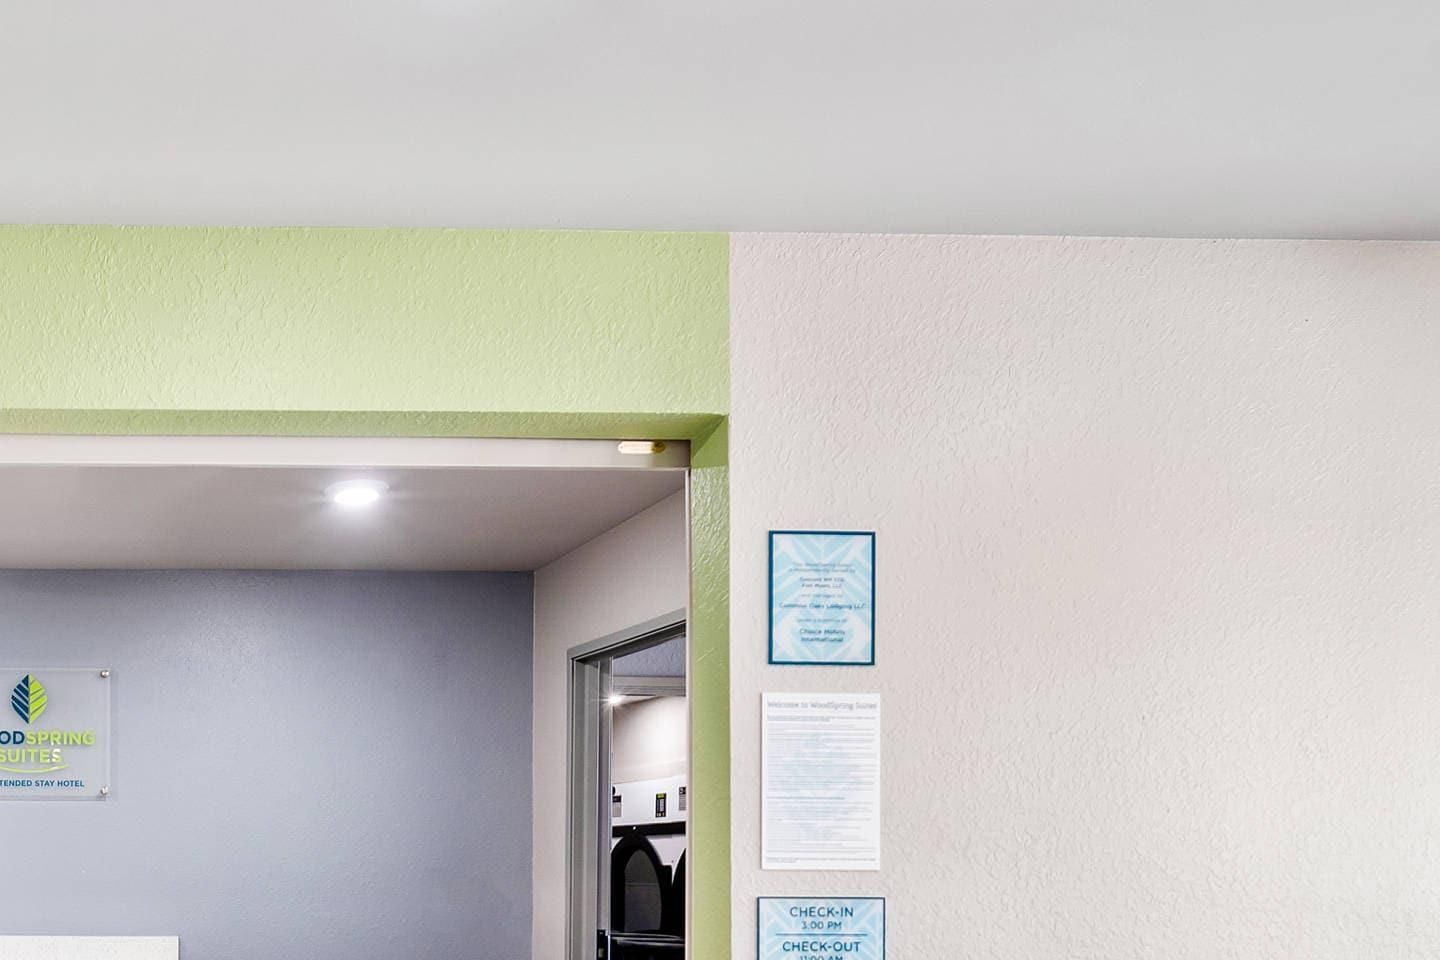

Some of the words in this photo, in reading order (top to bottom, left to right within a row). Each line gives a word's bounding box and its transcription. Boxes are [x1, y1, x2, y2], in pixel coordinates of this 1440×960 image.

[57, 780, 85, 788] HOTEL
[789, 906, 854, 918] CHECK-IN
[801, 921, 824, 930] 3:00
[827, 921, 842, 930] PM
[782, 941, 861, 953] CHECK-OUT
